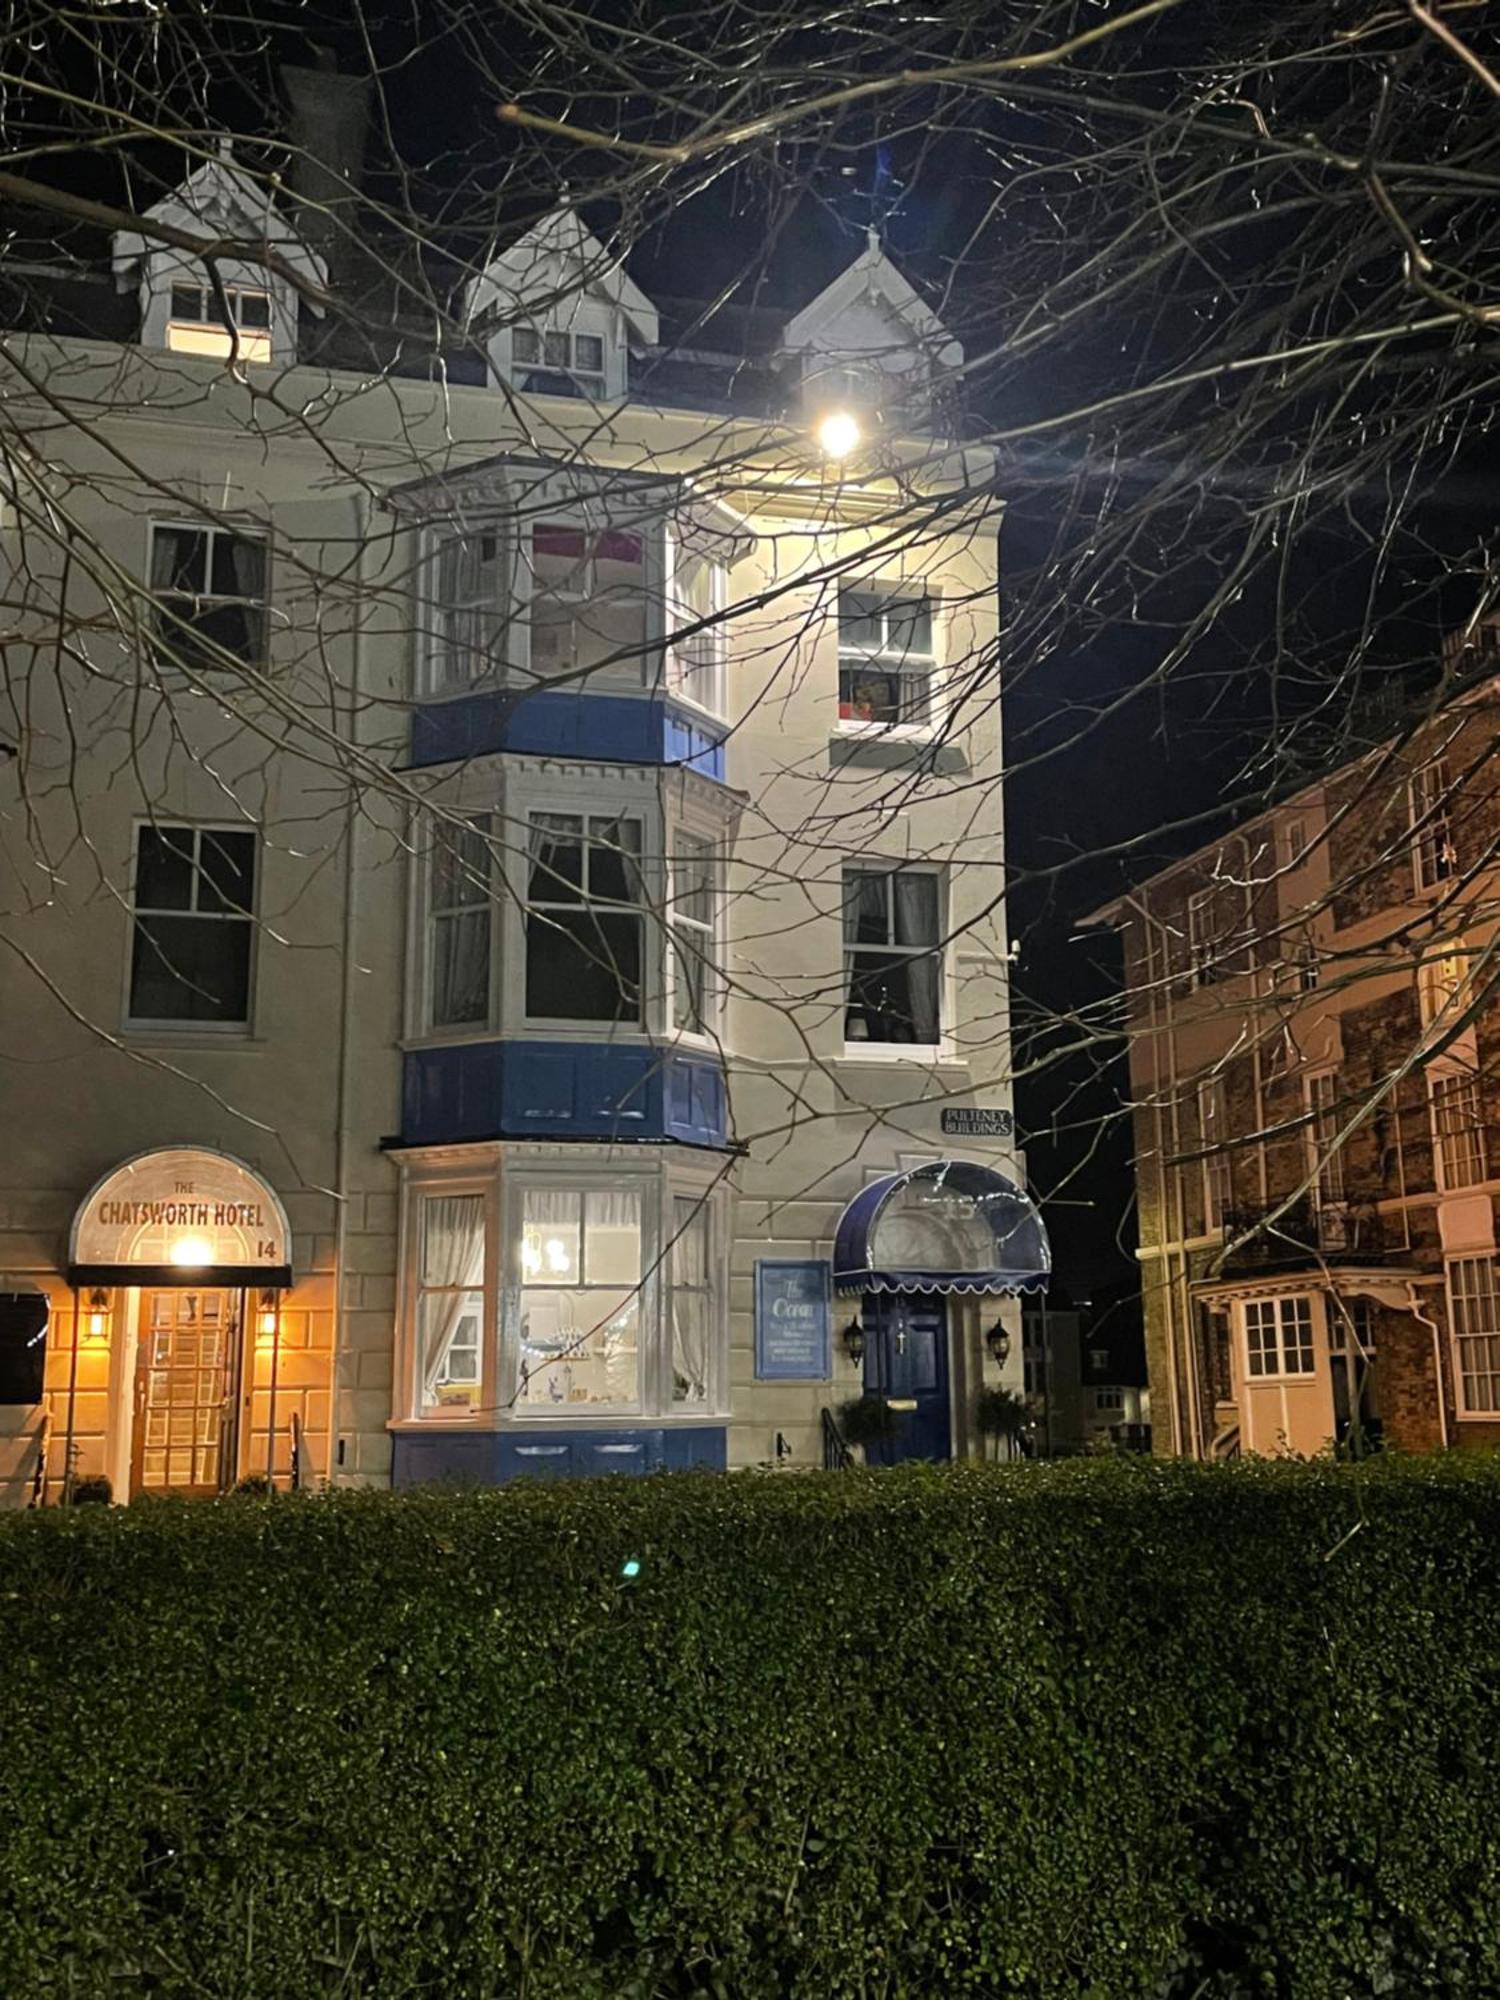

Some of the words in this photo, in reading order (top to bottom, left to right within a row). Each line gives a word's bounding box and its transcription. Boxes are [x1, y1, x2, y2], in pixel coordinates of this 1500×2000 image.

[945, 1109, 1006, 1123] PULTENEY
[945, 1121, 1009, 1135] BUILDINGS
[174, 1181, 195, 1194] THE
[99, 1202, 207, 1226] CHATSWORTH
[214, 1204, 264, 1228] HOTEL
[257, 1241, 277, 1259] 14
